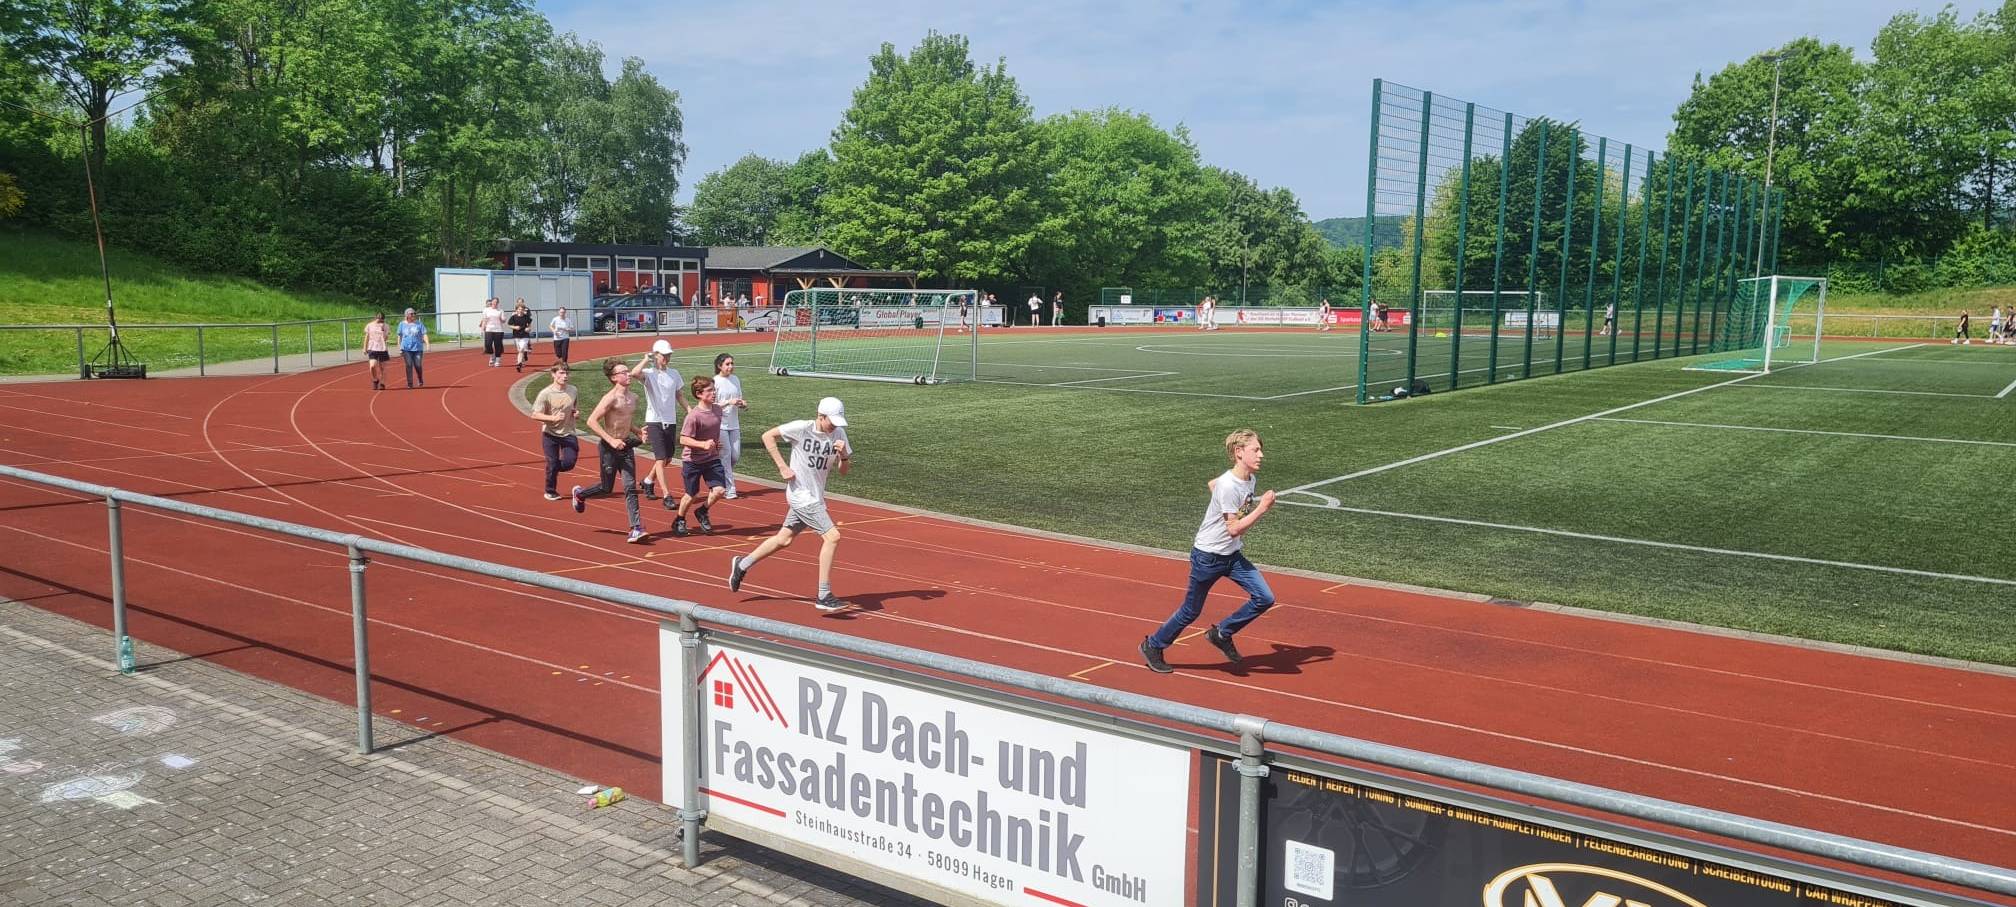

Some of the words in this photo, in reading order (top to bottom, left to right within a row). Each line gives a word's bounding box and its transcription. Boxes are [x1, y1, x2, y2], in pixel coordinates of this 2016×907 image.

[876, 310, 899, 319] Global
[808, 456, 829, 470] SOL
[799, 676, 848, 745] RZ
[862, 691, 984, 777] Dach-
[999, 741, 1087, 808] und
[714, 719, 1085, 883] Fassadentechnik
[1092, 864, 1146, 903] GmbH
[795, 810, 893, 853] Steinhausstraße
[897, 841, 912, 859] 34
[928, 850, 969, 876] 58099
[973, 864, 1013, 891] Hagen
